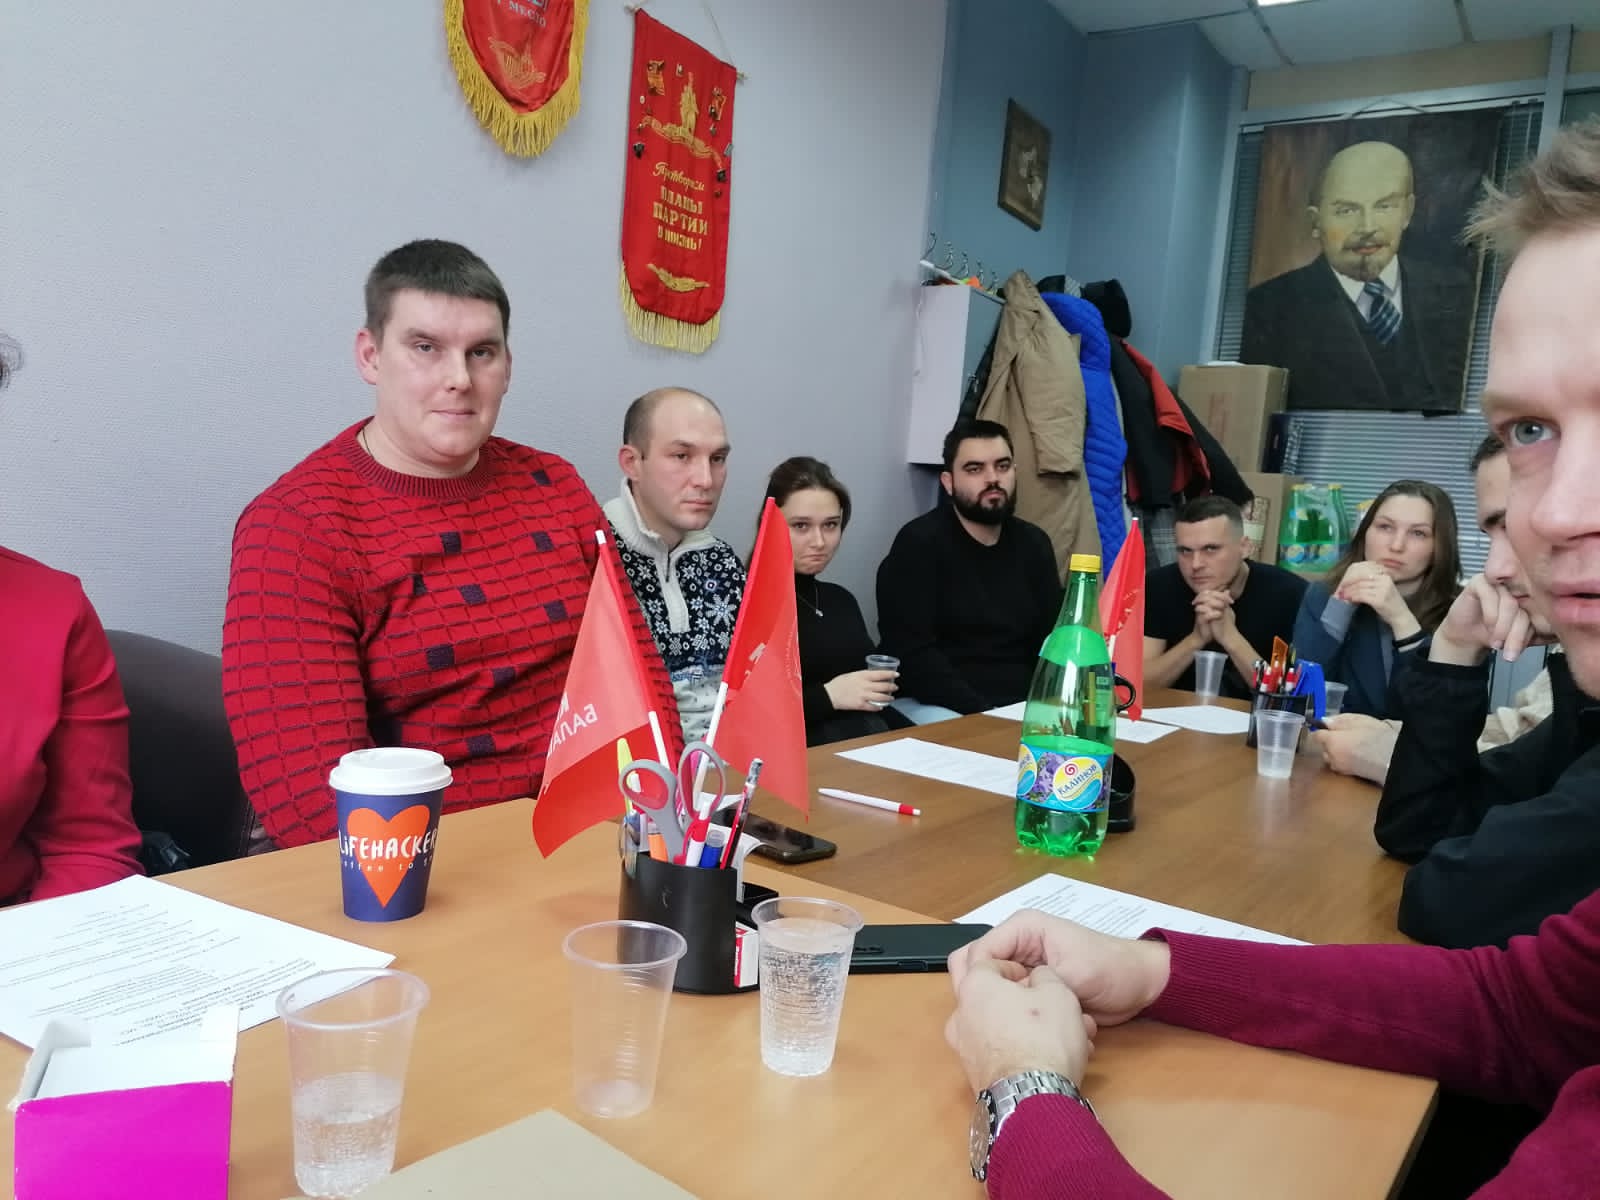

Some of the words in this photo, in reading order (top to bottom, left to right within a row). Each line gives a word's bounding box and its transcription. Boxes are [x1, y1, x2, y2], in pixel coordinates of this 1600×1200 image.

[660, 185, 703, 214] ПЛАНЫ
[653, 201, 708, 235] ПАРТИИ
[1058, 764, 1098, 795] КАЛИНОВ
